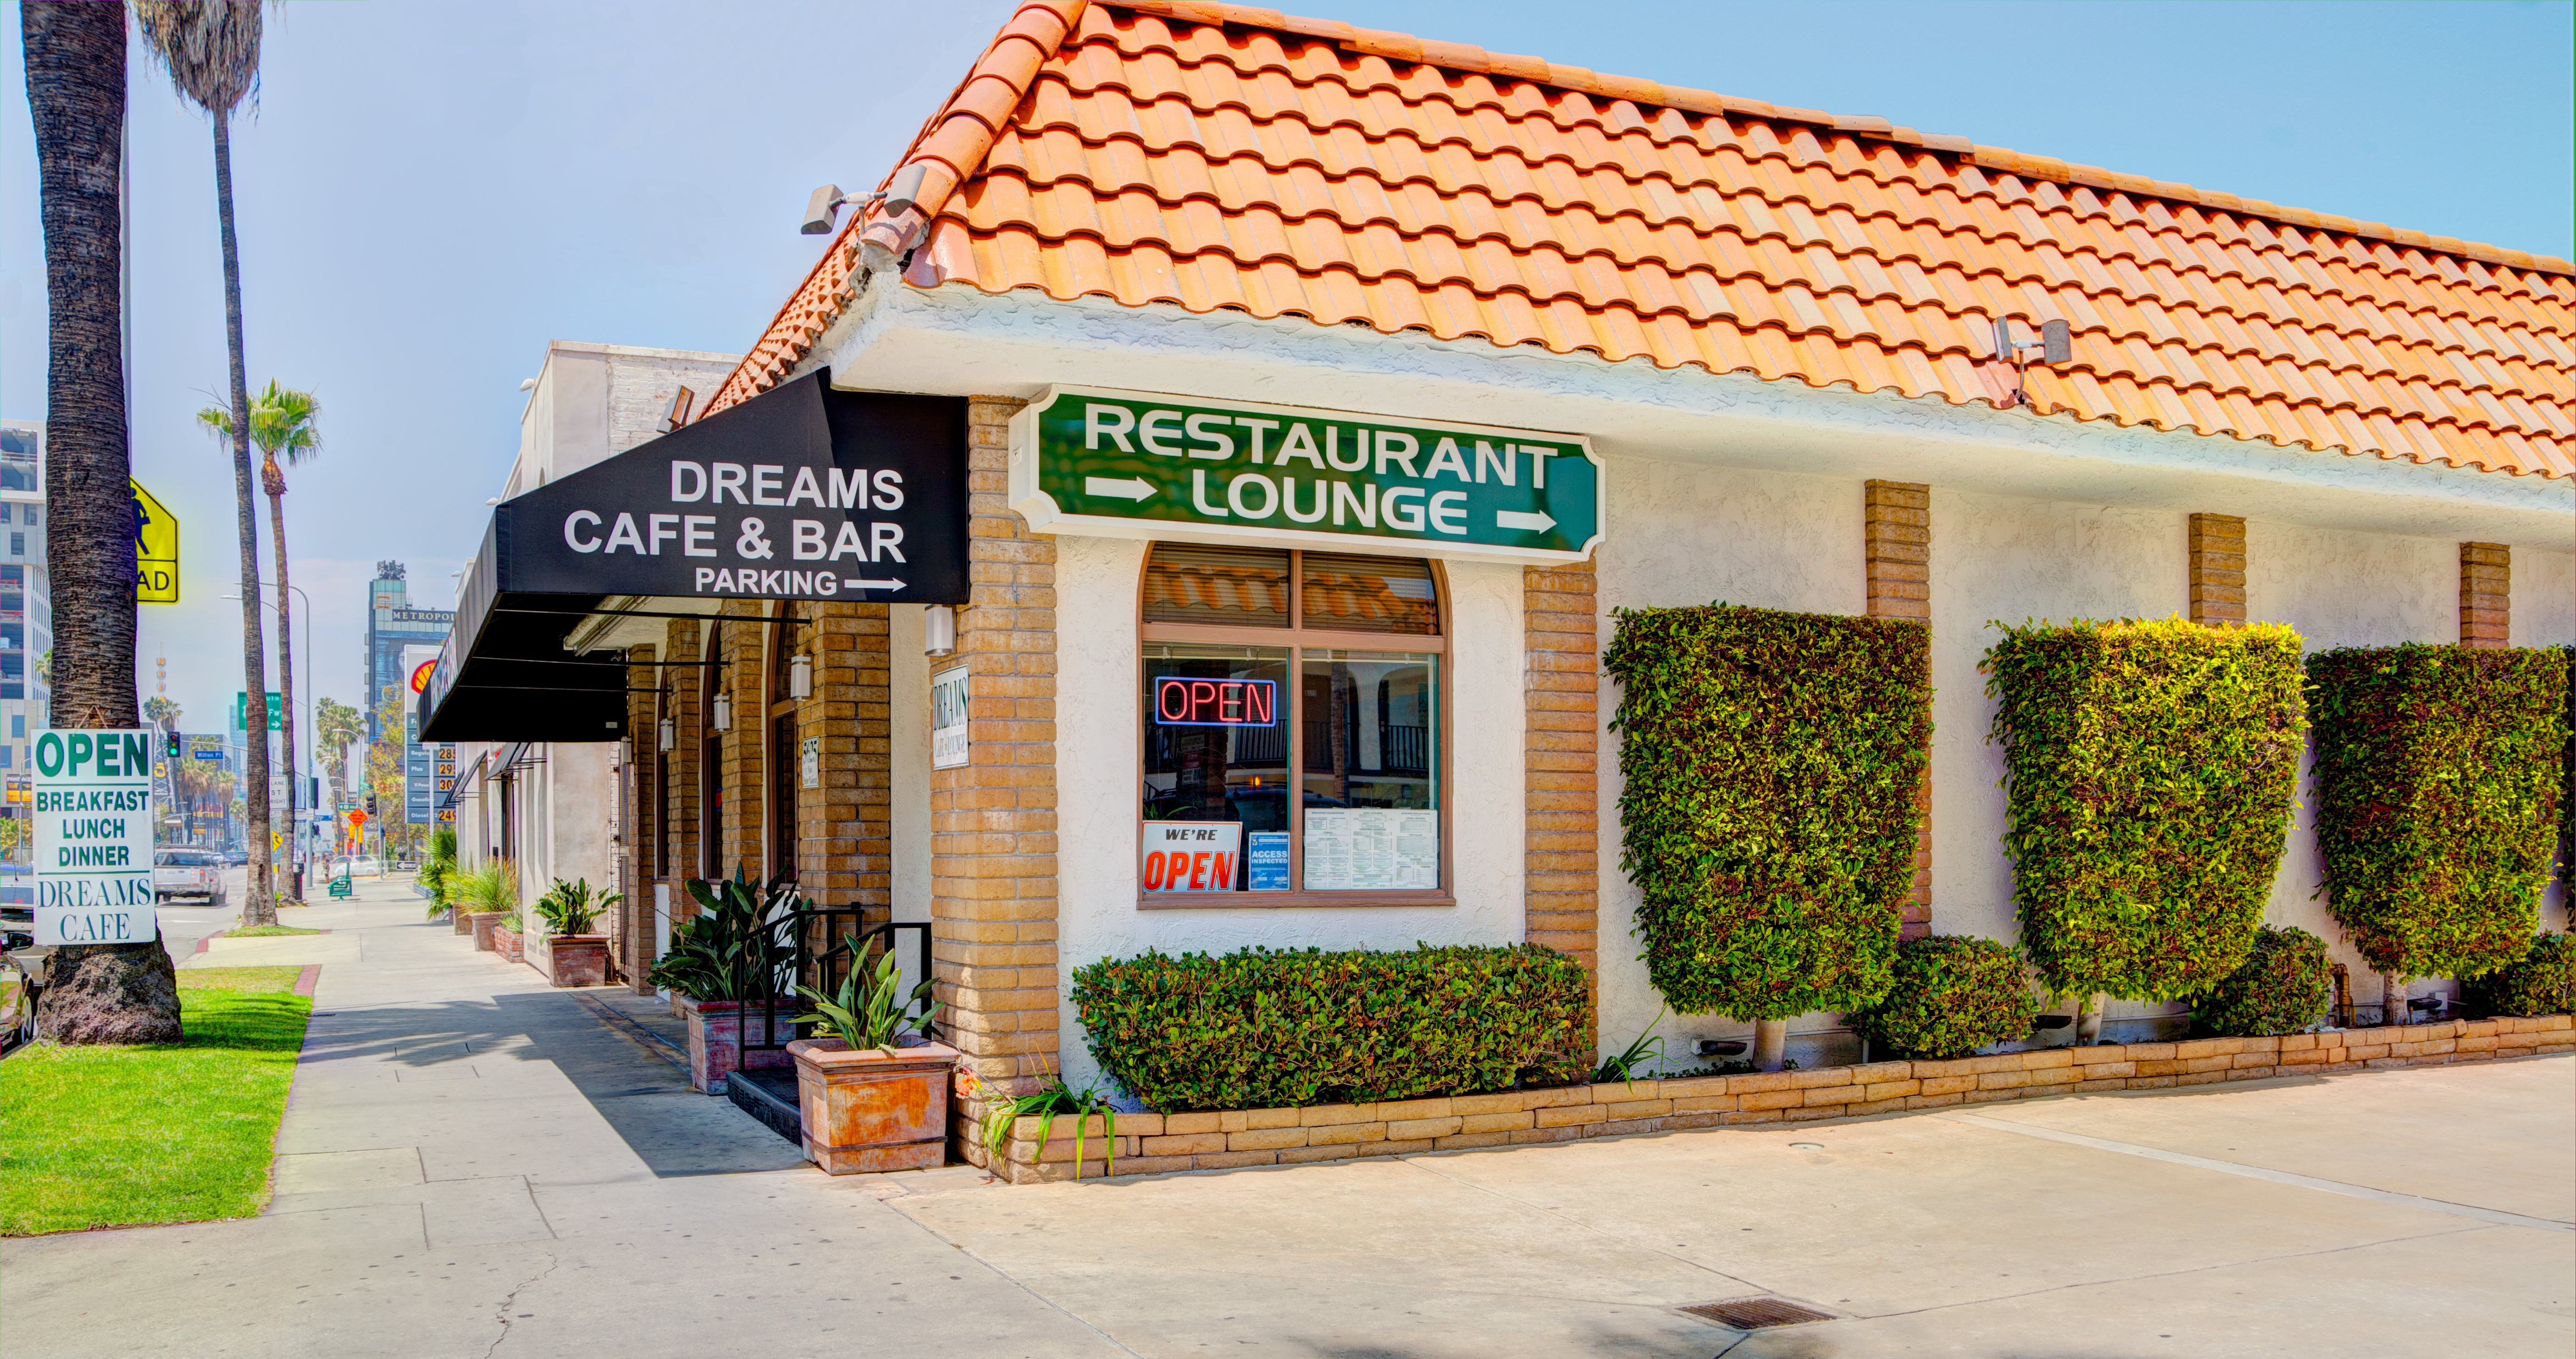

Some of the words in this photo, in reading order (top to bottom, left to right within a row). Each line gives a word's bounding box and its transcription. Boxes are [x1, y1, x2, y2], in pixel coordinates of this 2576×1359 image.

[1085, 402, 1558, 490] RESTAURANT
[672, 460, 905, 511] DREAMS
[1193, 469, 1467, 535] LOUNGE
[564, 510, 717, 557] CAFE
[736, 516, 774, 560] &
[793, 519, 906, 564] BAR
[138, 570, 169, 591] AD
[695, 567, 838, 595] PARKING
[393, 611, 455, 621] METROPOL
[934, 677, 966, 731] DREAMS
[1161, 681, 1271, 722] OPEN
[36, 732, 148, 777] OPEN
[804, 740, 816, 764] 5625
[935, 738, 944, 757] CAFE
[948, 734, 966, 755] LOUNGE
[440, 780, 455, 790] 30
[37, 791, 149, 811] BREAKFAST
[63, 818, 125, 839] LUNCH
[1166, 829, 1218, 841] WE'RE
[59, 846, 129, 866] DINNER
[1143, 850, 1235, 891] OPEN
[38, 879, 150, 908] DREAMS
[60, 913, 131, 942] CAFE
